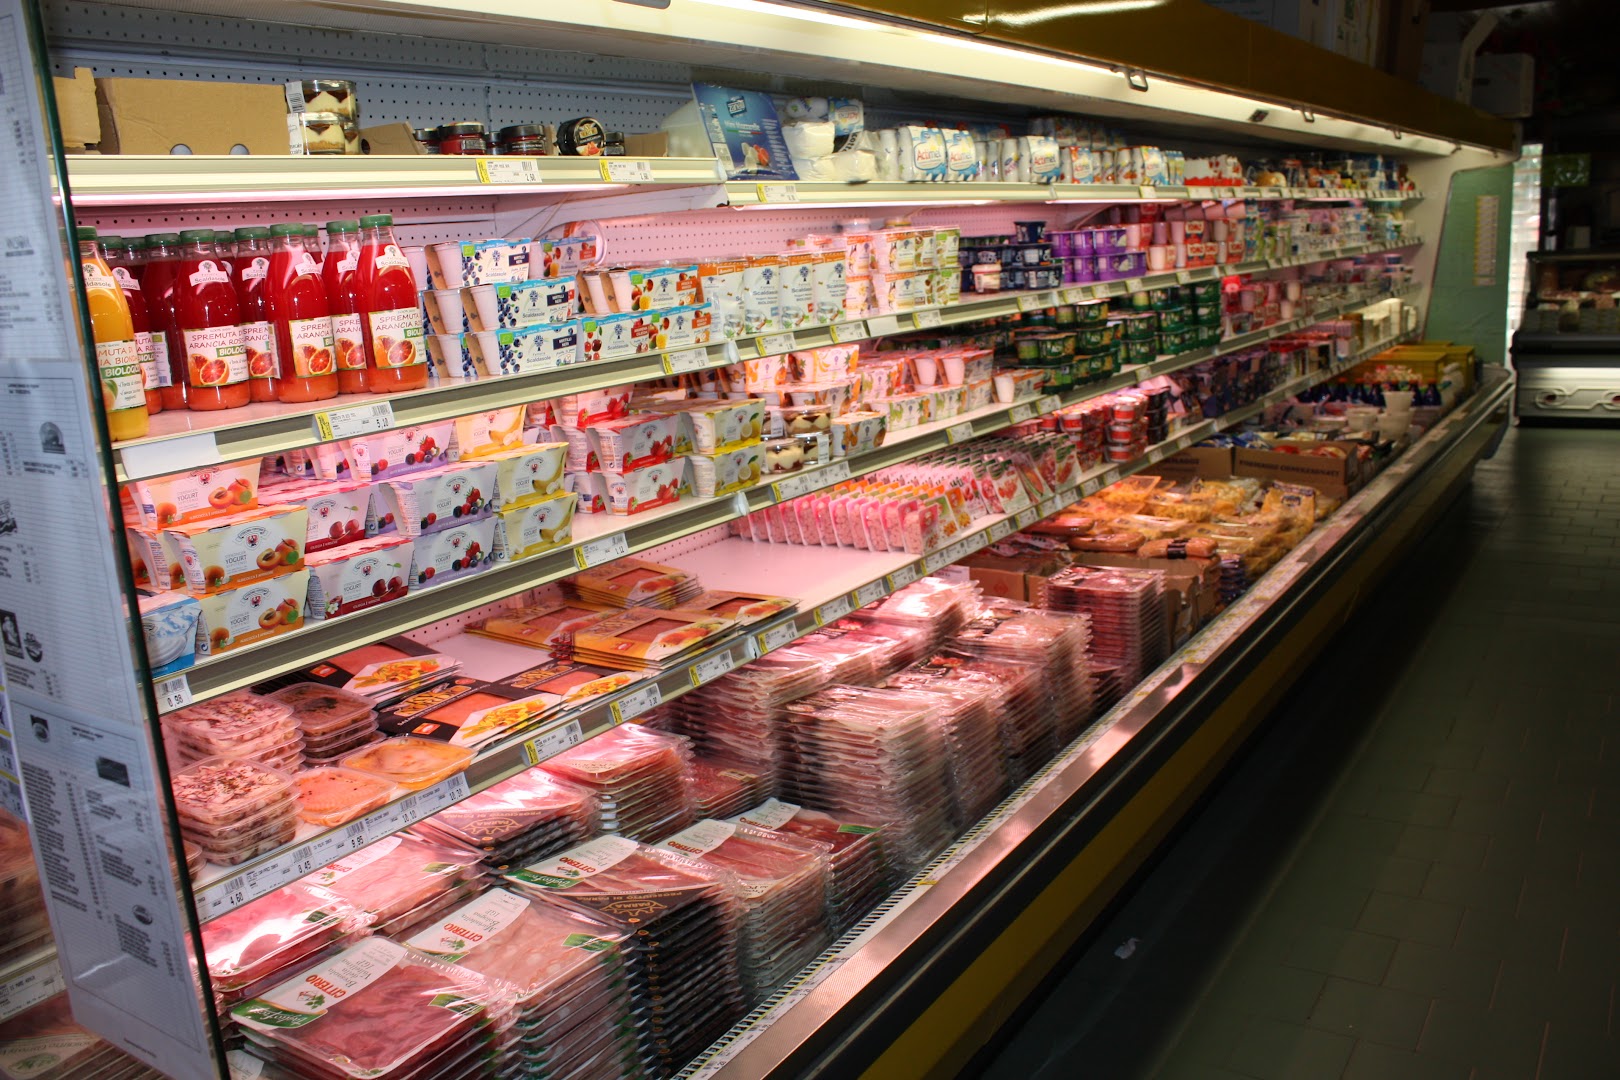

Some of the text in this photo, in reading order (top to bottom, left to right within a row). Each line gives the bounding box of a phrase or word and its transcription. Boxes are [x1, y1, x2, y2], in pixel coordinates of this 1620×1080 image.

[917, 151, 942, 162] Actimel
[951, 151, 972, 162] Actimel
[1034, 155, 1056, 166] Actimel
[339, 319, 361, 327] SPRE
[379, 314, 419, 324] SPREMUTA
[376, 321, 413, 331] ARANCIA
[192, 331, 237, 342] SPREMUTA
[669, 333, 690, 341] Scaldasole
[188, 340, 227, 349] ARANCIA
[607, 343, 629, 351] Scaldasole
[526, 355, 552, 364] Scaldasole
[388, 447, 404, 456] YOGURT
[516, 479, 530, 487] YOGURT
[177, 491, 199, 501] YOGURT
[437, 500, 452, 509] YOGURT
[523, 529, 537, 537] YOGURT
[225, 555, 247, 564] YOGURT
[435, 555, 451, 563] YOGURT
[344, 583, 362, 592] YOGURT
[230, 614, 250, 625] YOGURT
[739, 816, 774, 830] CITTERIO
[351, 834, 365, 849] 9,95
[667, 839, 704, 855] CITTERIO
[297, 860, 312, 875] 8,45
[558, 856, 596, 874] CITTERIO
[229, 890, 245, 907] 4,60
[615, 901, 652, 910] PARMA
[461, 913, 497, 933] Mortadella
[473, 911, 501, 926] Bologna
[443, 922, 483, 943] CITTERIO
[341, 957, 373, 981] Valtellina
[356, 958, 375, 970] IGP
[327, 967, 356, 988] Bresaola
[343, 967, 361, 980] della
[305, 973, 347, 999] CITTERIO
